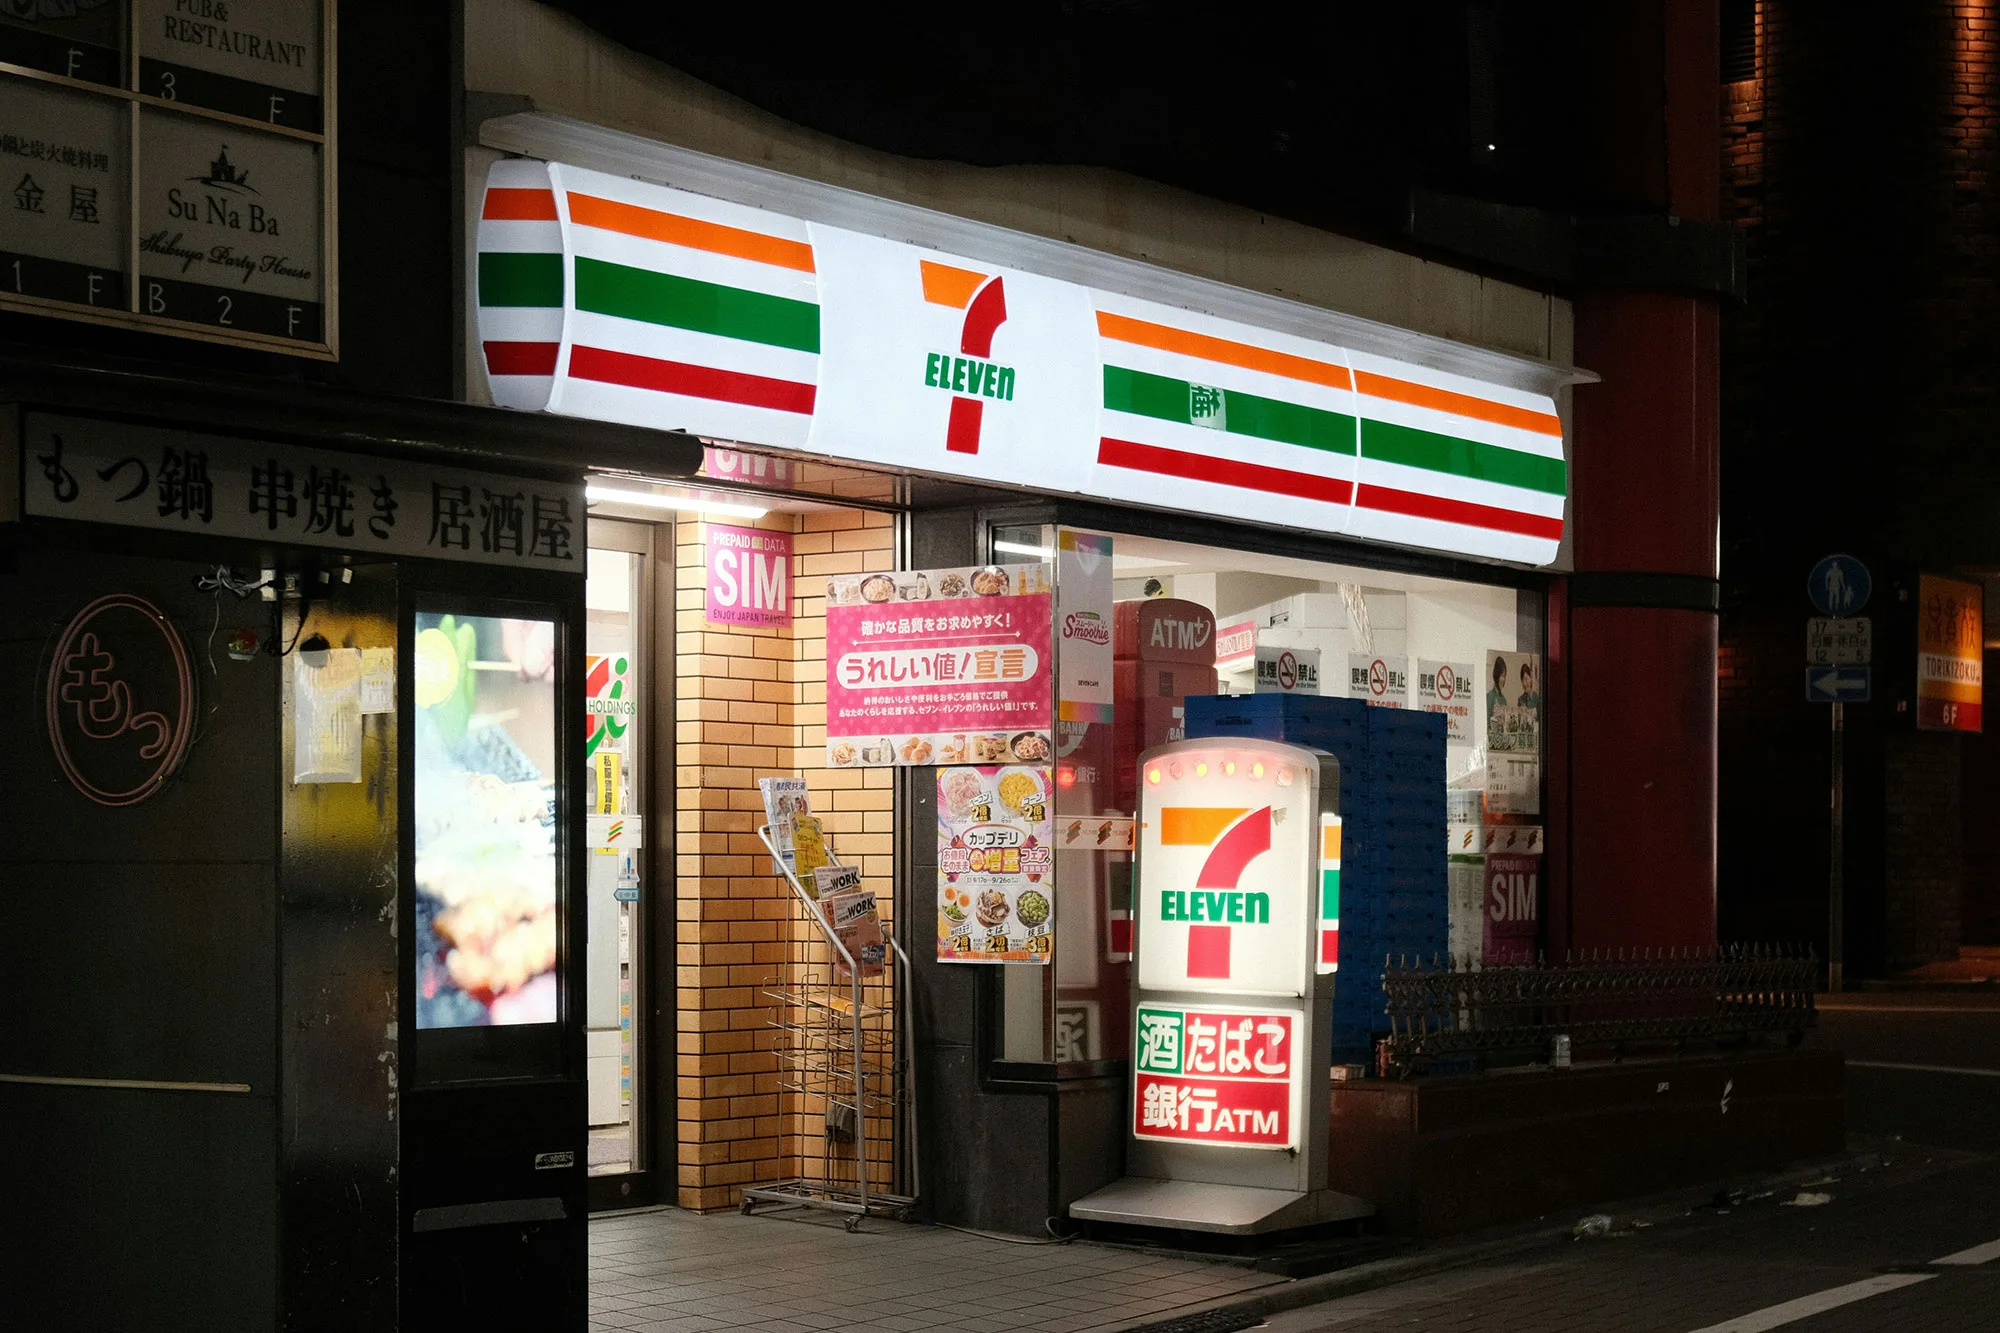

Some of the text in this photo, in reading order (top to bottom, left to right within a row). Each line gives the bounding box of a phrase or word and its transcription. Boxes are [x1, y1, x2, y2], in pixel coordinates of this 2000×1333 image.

[164, 15, 306, 69] RESTAURANT
[68, 47, 83, 77] F
[168, 188, 280, 237] Su Na Ba
[209, 245, 257, 284] Party
[259, 254, 312, 281] House
[37, 433, 575, 561] もつ鍋 串焼き 居酒屋
[713, 531, 751, 549] PREPAID
[764, 537, 786, 552] DATA
[713, 549, 787, 612] SIM
[713, 608, 736, 620] ENJOY
[737, 611, 760, 623] JAPAN
[1063, 614, 1110, 641] Smoothie
[1151, 617, 1194, 650] ATM
[1926, 656, 1976, 682] TORIKIZOKU
[588, 699, 637, 715] HOLDINGS
[1943, 704, 1958, 726] 6F
[969, 832, 1019, 846] カップデリ
[830, 870, 861, 891] WORK
[847, 896, 877, 919] WORK
[1489, 873, 1537, 922] SIM
[1139, 1013, 1181, 1070] 酒
[1185, 1016, 1287, 1075] たばこ
